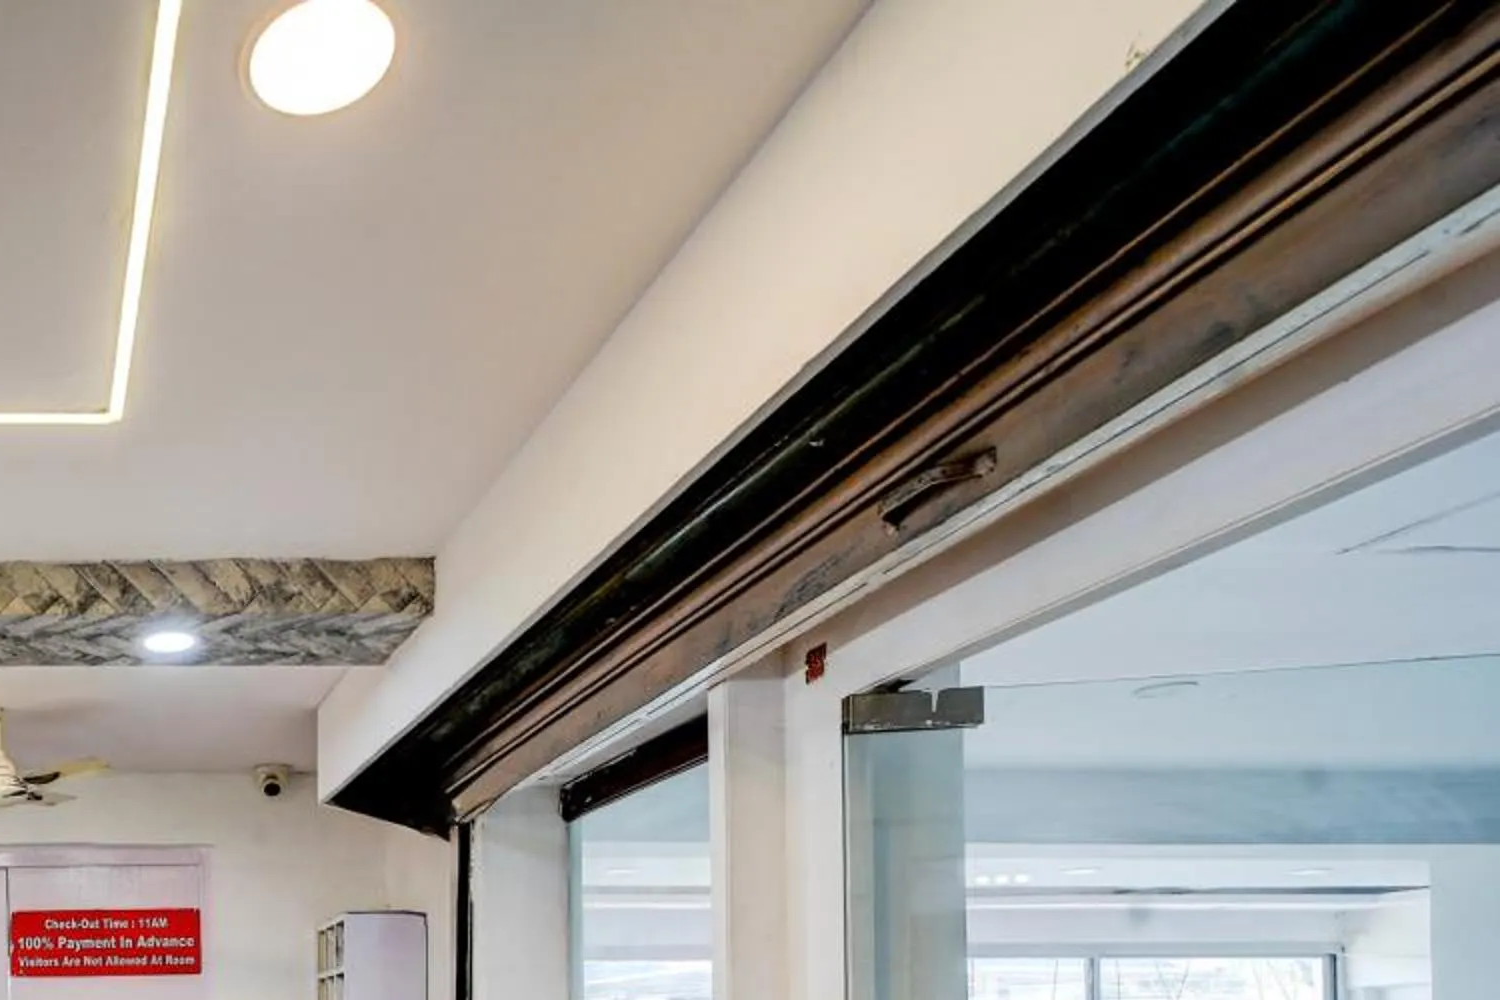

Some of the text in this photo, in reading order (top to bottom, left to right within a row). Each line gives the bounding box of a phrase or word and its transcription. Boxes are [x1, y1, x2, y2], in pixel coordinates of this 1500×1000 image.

[44, 918, 100, 929] Check-Out
[103, 918, 128, 928] Time
[138, 917, 168, 928] 11AM
[18, 935, 195, 951] 100% Payment In Advance
[18, 957, 59, 967] Visitors
[62, 956, 81, 966] Are
[83, 956, 102, 966] Not
[105, 955, 148, 965] Allowed
